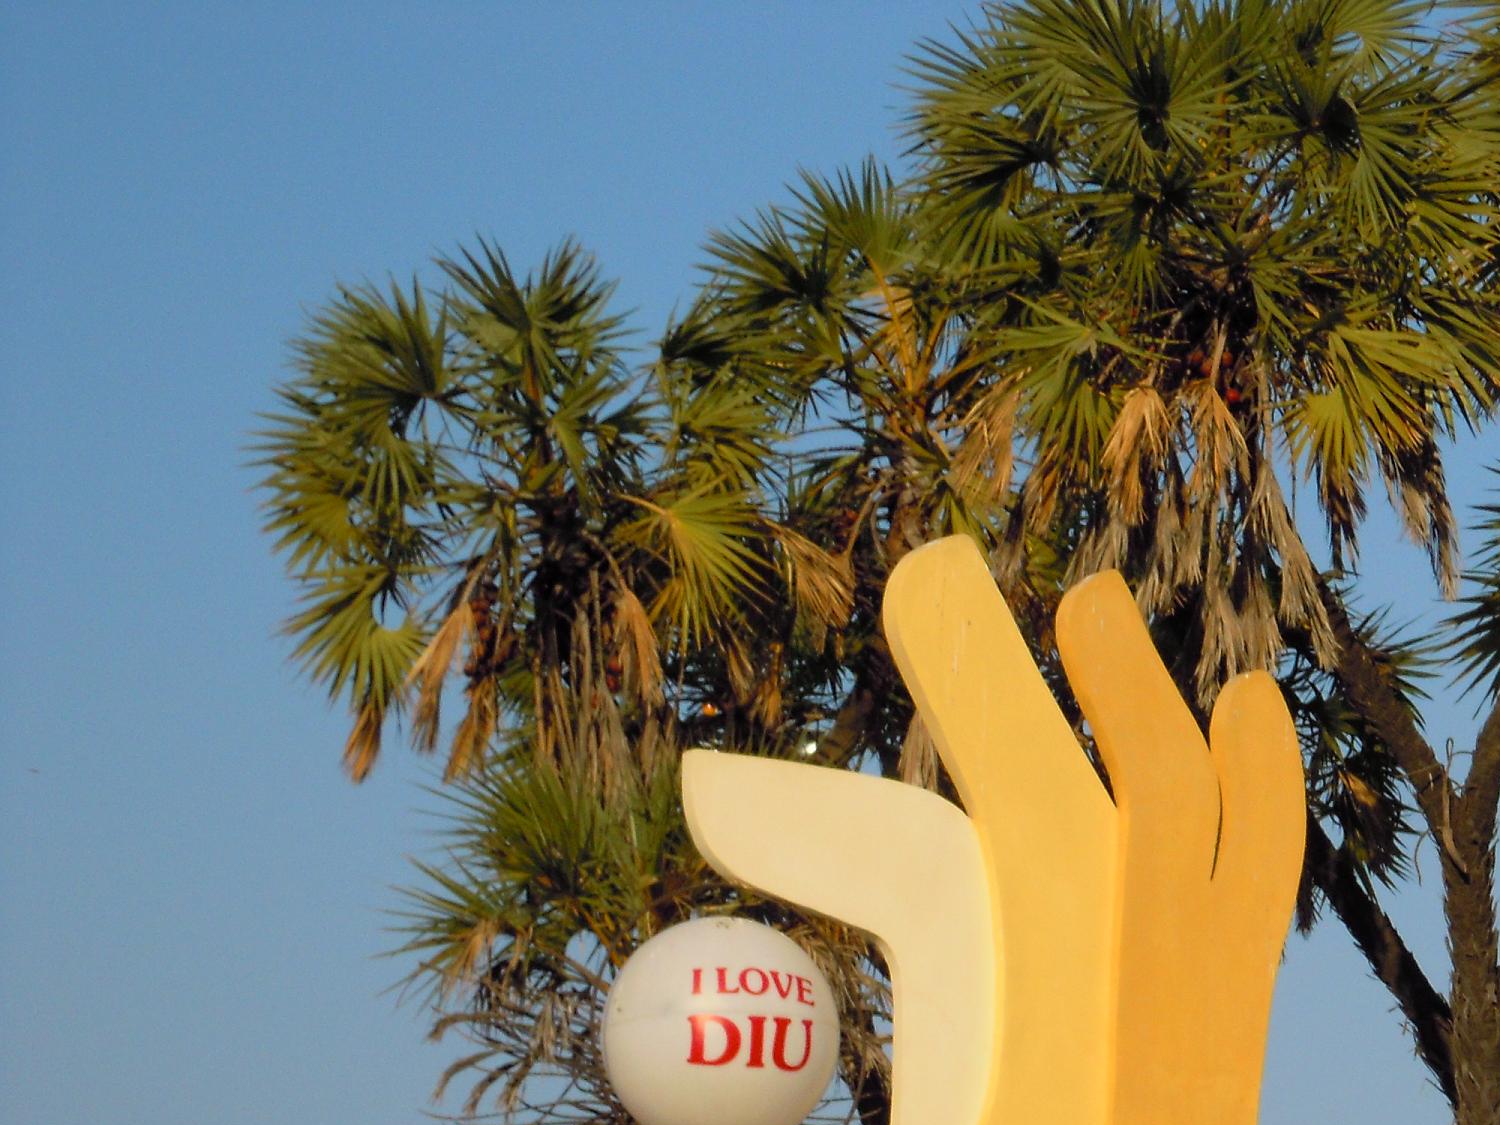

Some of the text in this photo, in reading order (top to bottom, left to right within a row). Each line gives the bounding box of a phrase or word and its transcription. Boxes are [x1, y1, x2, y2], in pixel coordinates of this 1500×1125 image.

[691, 967, 815, 1007] I LOVE
[687, 1014, 813, 1072] DIU
